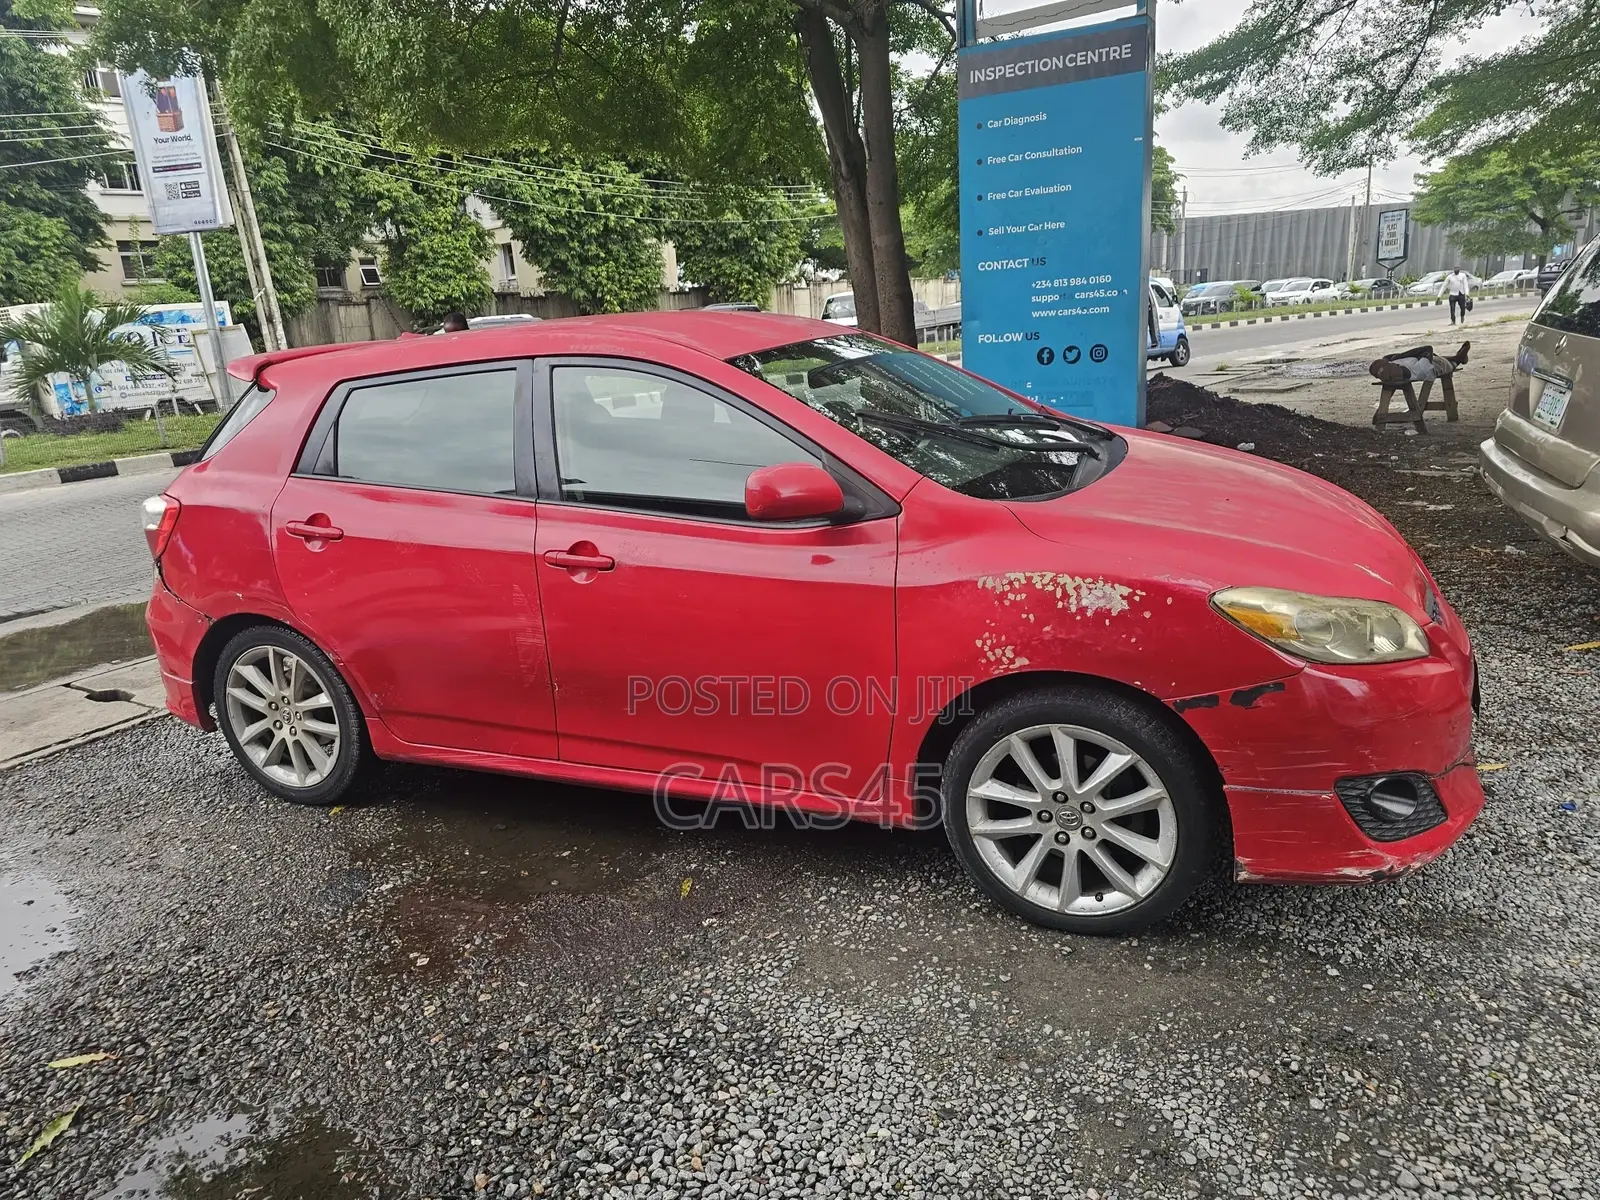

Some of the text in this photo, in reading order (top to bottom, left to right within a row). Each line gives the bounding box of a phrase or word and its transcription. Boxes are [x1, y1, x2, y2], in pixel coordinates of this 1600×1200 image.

[969, 43, 1132, 84] INSPECTION CENTRE
[987, 111, 1048, 129] Car Diagnosis
[987, 144, 1083, 165] Free Car Consultation
[987, 182, 1072, 201] Free Car Evaluation
[988, 220, 1065, 236] Sell Your Car Here
[977, 256, 1047, 271] CONTACT US
[1031, 274, 1112, 289] +234 813 984 0160
[977, 331, 1040, 344] FOLLOW US
